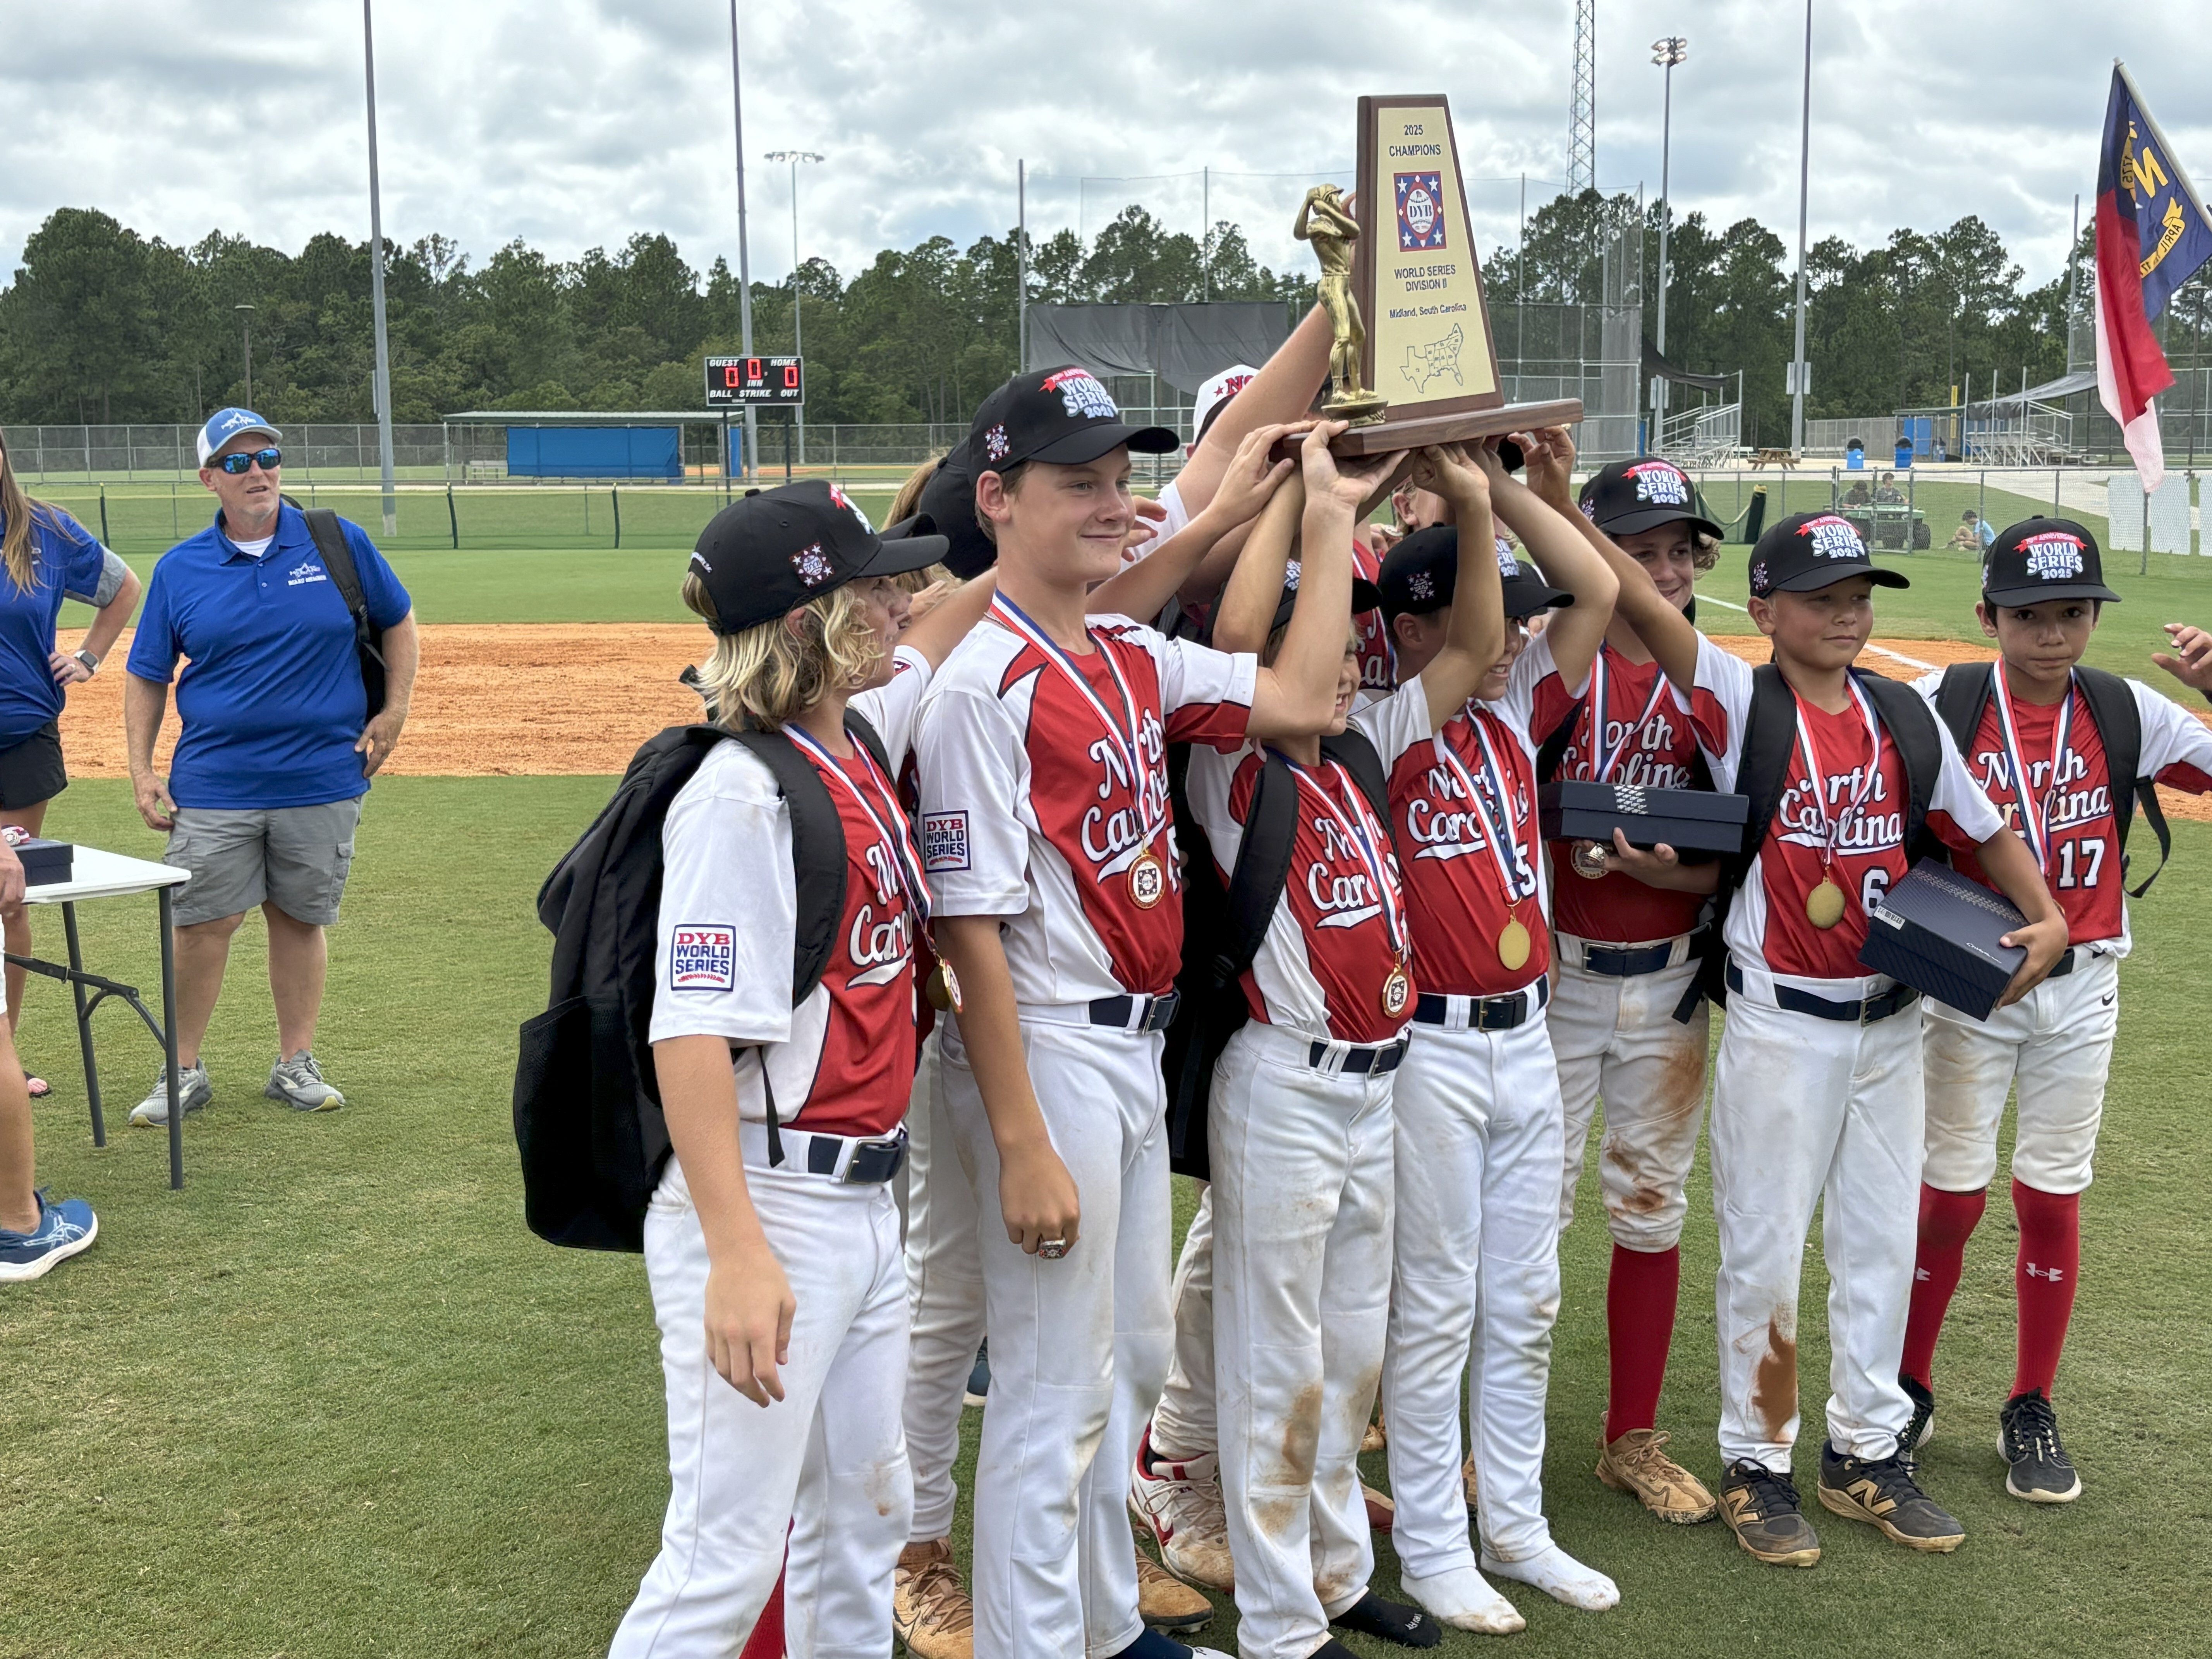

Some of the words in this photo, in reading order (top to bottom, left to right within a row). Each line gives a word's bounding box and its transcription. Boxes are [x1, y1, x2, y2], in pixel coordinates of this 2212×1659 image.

[1404, 124, 1423, 136] 2025
[1389, 144, 1441, 156] CHAMPIONS
[1409, 205, 1432, 218] DYB
[1394, 266, 1425, 279] WORLD
[1427, 264, 1456, 276] SERIES
[1406, 279, 1441, 291] DIVISION
[1419, 306, 1438, 315] South
[1440, 302, 1467, 313] Carolina
[725, 367, 740, 387] 0
[747, 359, 762, 380] 0
[785, 367, 799, 387] 0
[780, 389, 799, 397] OUT
[1637, 470, 1682, 486] WORLD
[1637, 482, 1688, 503] SERIES
[1809, 524, 1857, 539] WORLD
[1812, 536, 1865, 556] SERIES
[1828, 548, 1858, 559] 2025
[2028, 542, 2078, 558] WORLD
[2027, 555, 2083, 575] SERIES
[2041, 568, 2072, 580] 2025
[926, 819, 964, 832] DYB
[926, 830, 964, 844] WORLD
[927, 842, 965, 859] SERIES
[2058, 839, 2105, 888] 17
[1862, 869, 1889, 918] 6
[677, 933, 730, 945] DYB
[676, 945, 730, 958] WORLD
[675, 959, 730, 975] SERIES
